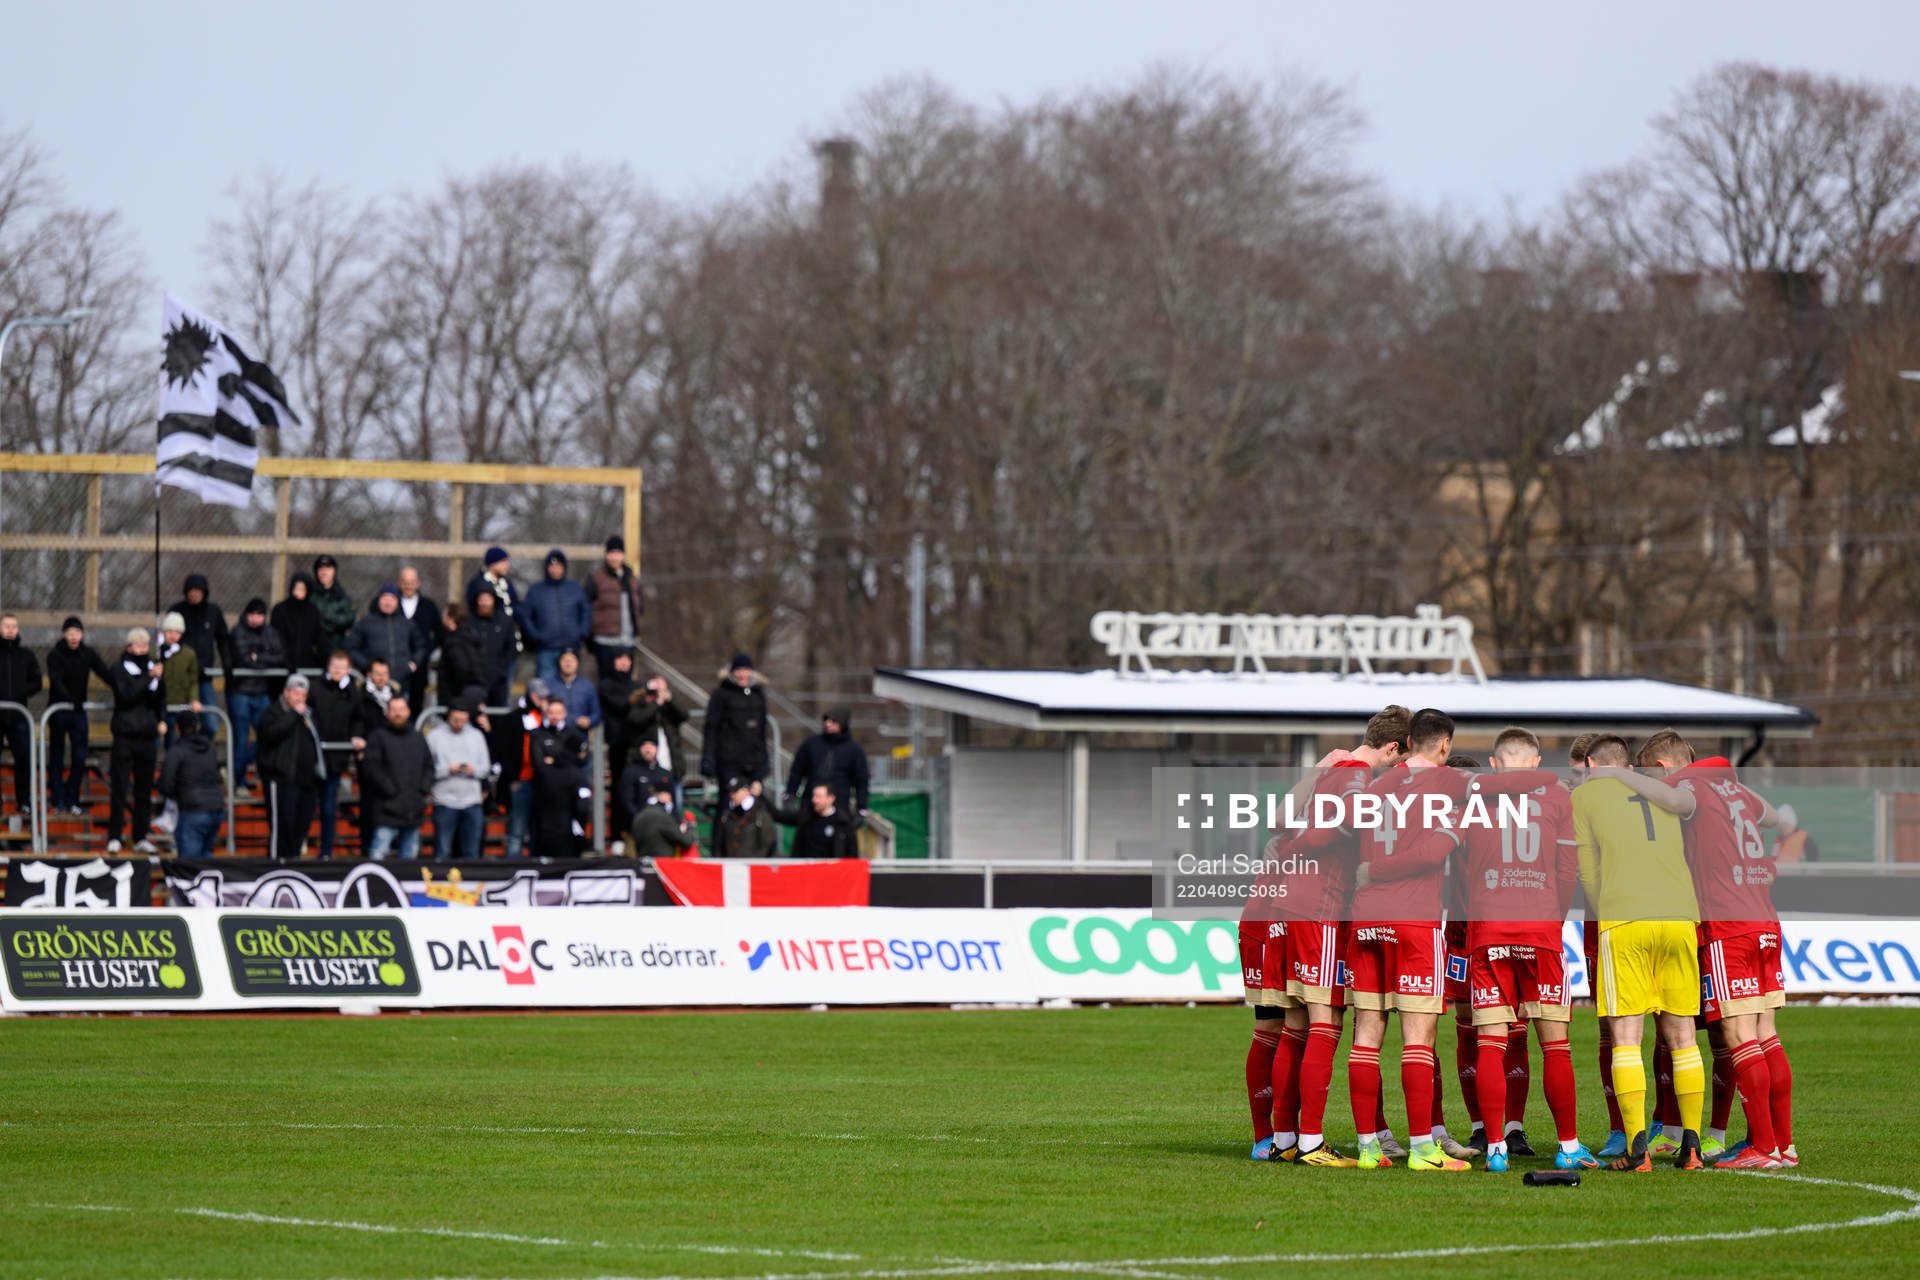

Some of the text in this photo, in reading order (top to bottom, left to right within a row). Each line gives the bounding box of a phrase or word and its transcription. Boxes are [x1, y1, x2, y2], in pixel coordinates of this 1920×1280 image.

[1503, 868, 1546, 881] Söderberg
[13, 924, 177, 959] GRÖNSAKS
[235, 924, 396, 958] GRÖNSAKS
[1357, 927, 1377, 941] SN
[426, 937, 554, 973] DALOC
[566, 943, 725, 967] Säkra dörrar.
[778, 940, 1002, 971] INTERSPORT
[1029, 916, 1242, 991] coop
[1488, 945, 1510, 961] SN
[61, 959, 160, 988] HUSET
[283, 958, 380, 986] HUSET
[1399, 974, 1433, 987] PULS
[1730, 978, 1759, 991] PULS
